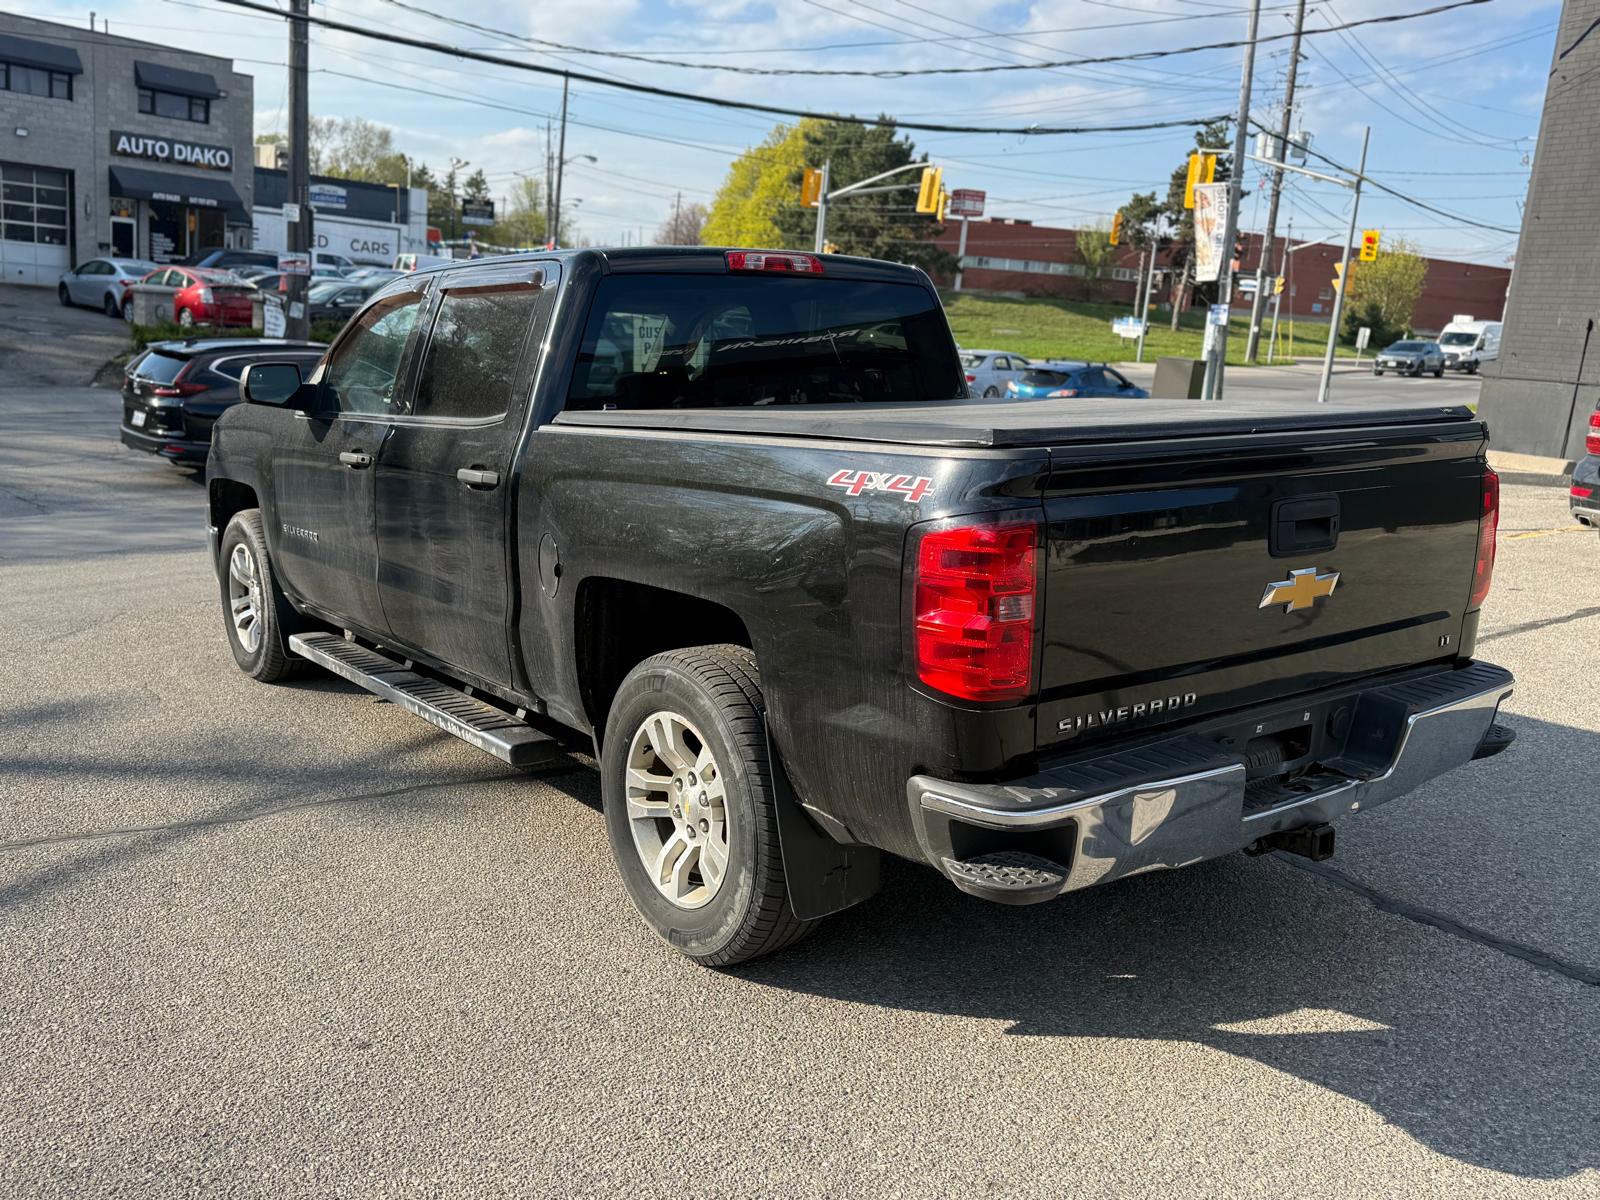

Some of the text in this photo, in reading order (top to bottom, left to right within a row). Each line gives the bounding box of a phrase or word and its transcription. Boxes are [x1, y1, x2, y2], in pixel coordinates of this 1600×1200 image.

[116, 135, 230, 168] AUTO DIAKO
[1217, 184, 1226, 220] SHOP
[350, 238, 390, 255] CARS
[283, 523, 319, 543] SILVERADO
[1058, 692, 1197, 734] SILVERADO
